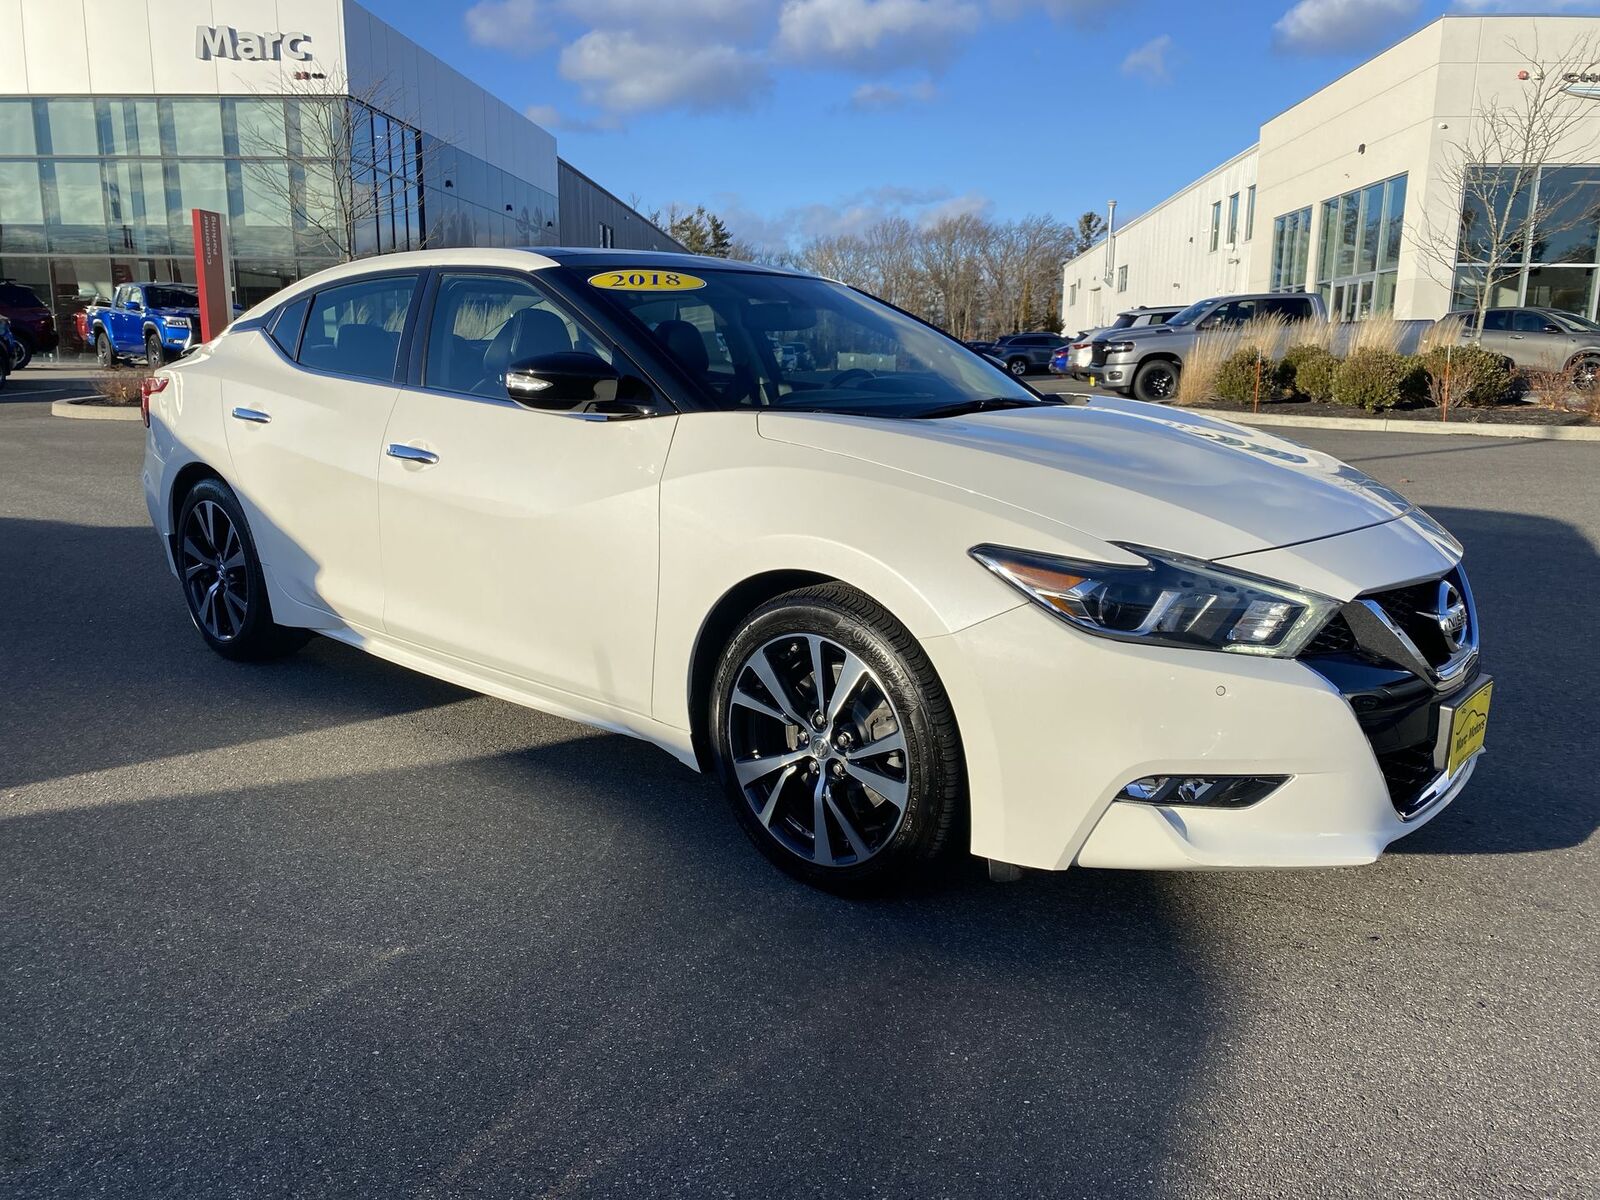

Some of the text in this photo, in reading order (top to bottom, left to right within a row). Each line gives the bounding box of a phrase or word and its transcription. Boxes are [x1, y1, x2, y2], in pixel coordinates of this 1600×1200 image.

[196, 25, 312, 61] Marc
[203, 214, 213, 265] Customer
[210, 215, 218, 256] Parking
[609, 273, 681, 287] 2018
